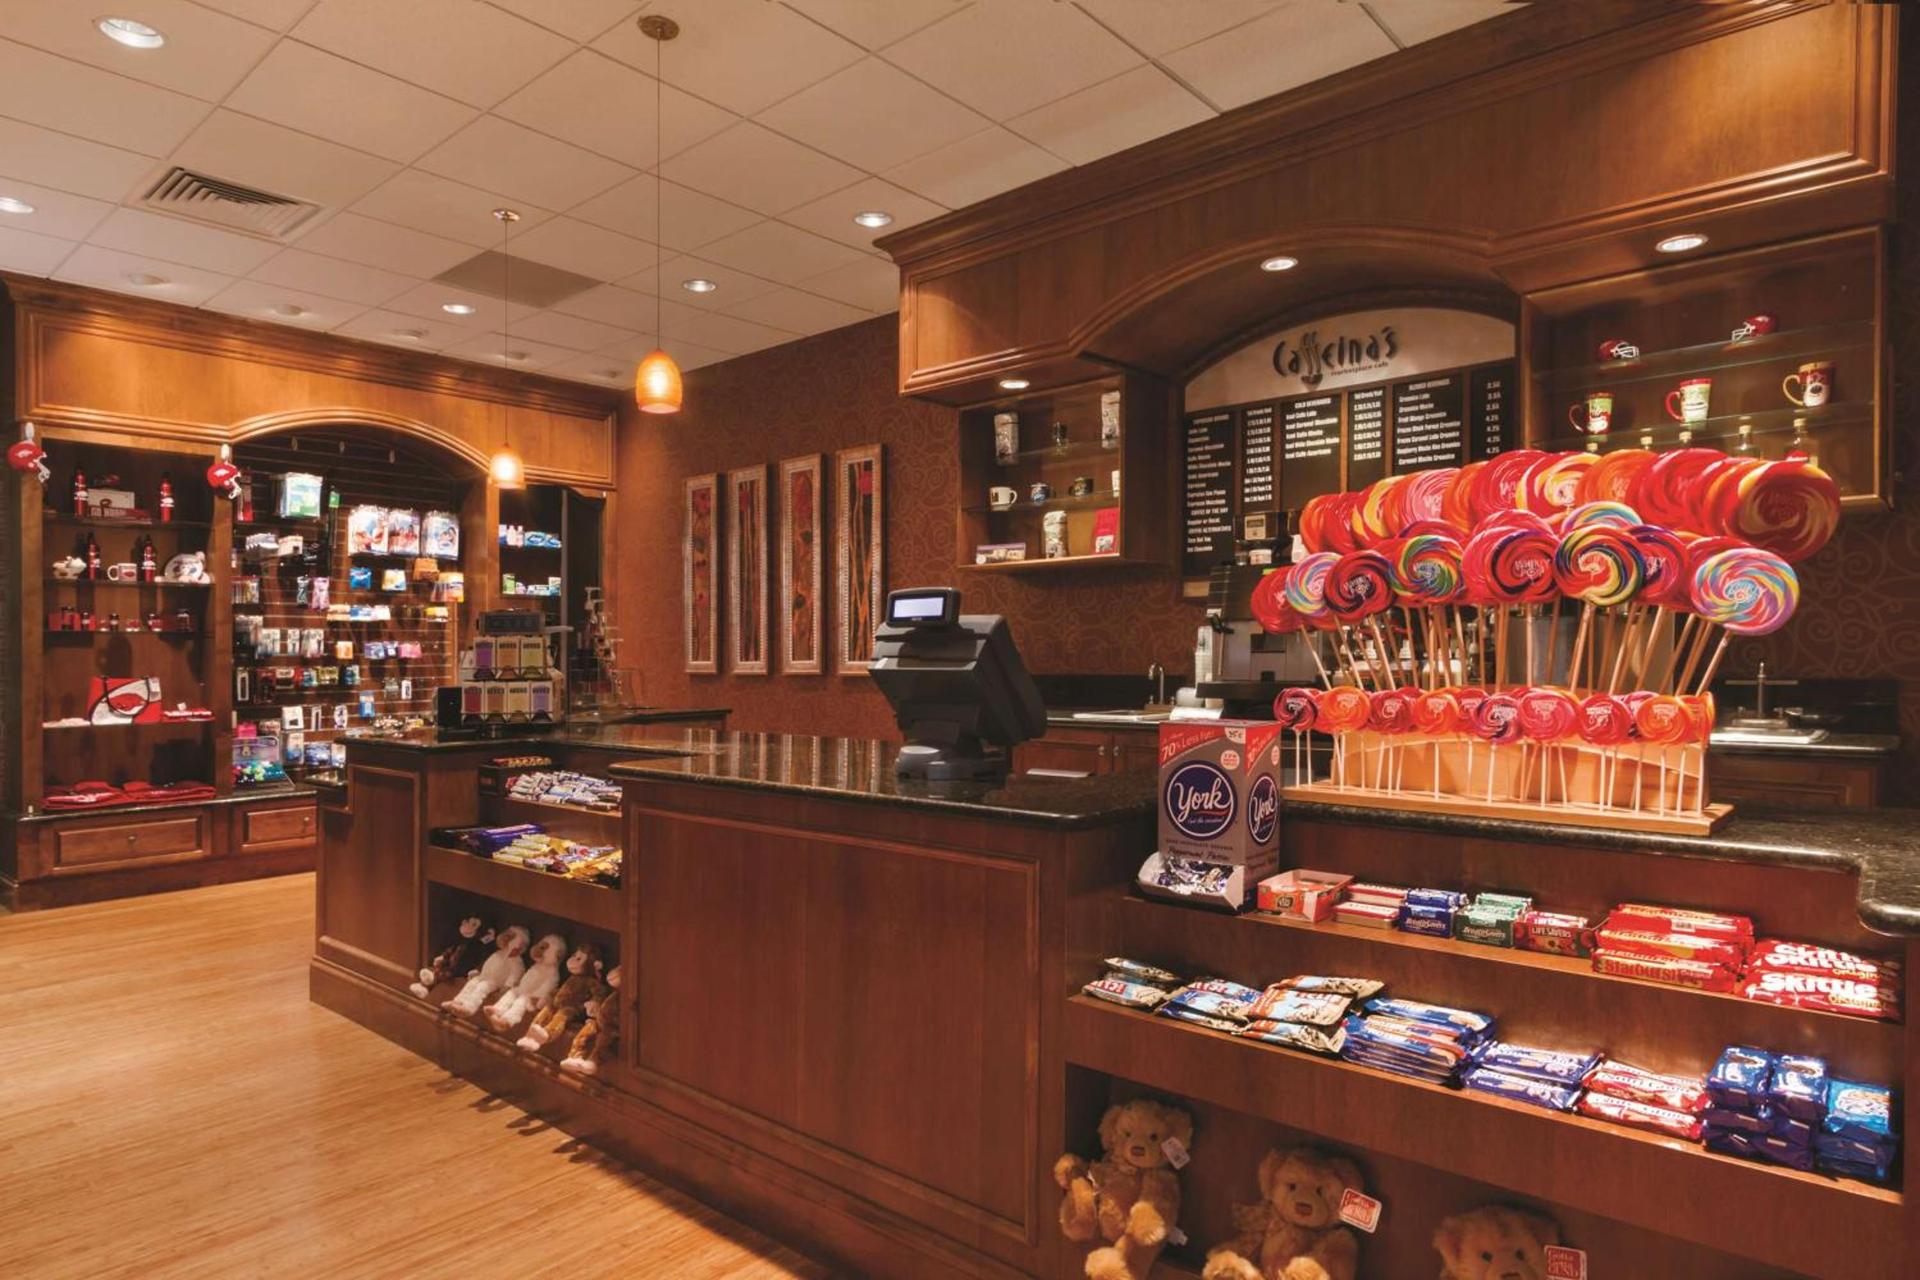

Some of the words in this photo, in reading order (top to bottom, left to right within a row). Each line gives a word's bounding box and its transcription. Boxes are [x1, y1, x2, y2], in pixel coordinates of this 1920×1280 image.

[1273, 326, 1398, 378] Caffeina's
[1174, 777, 1232, 823] York
[1253, 783, 1277, 835] York
[1547, 928, 1571, 938] SAVERS
